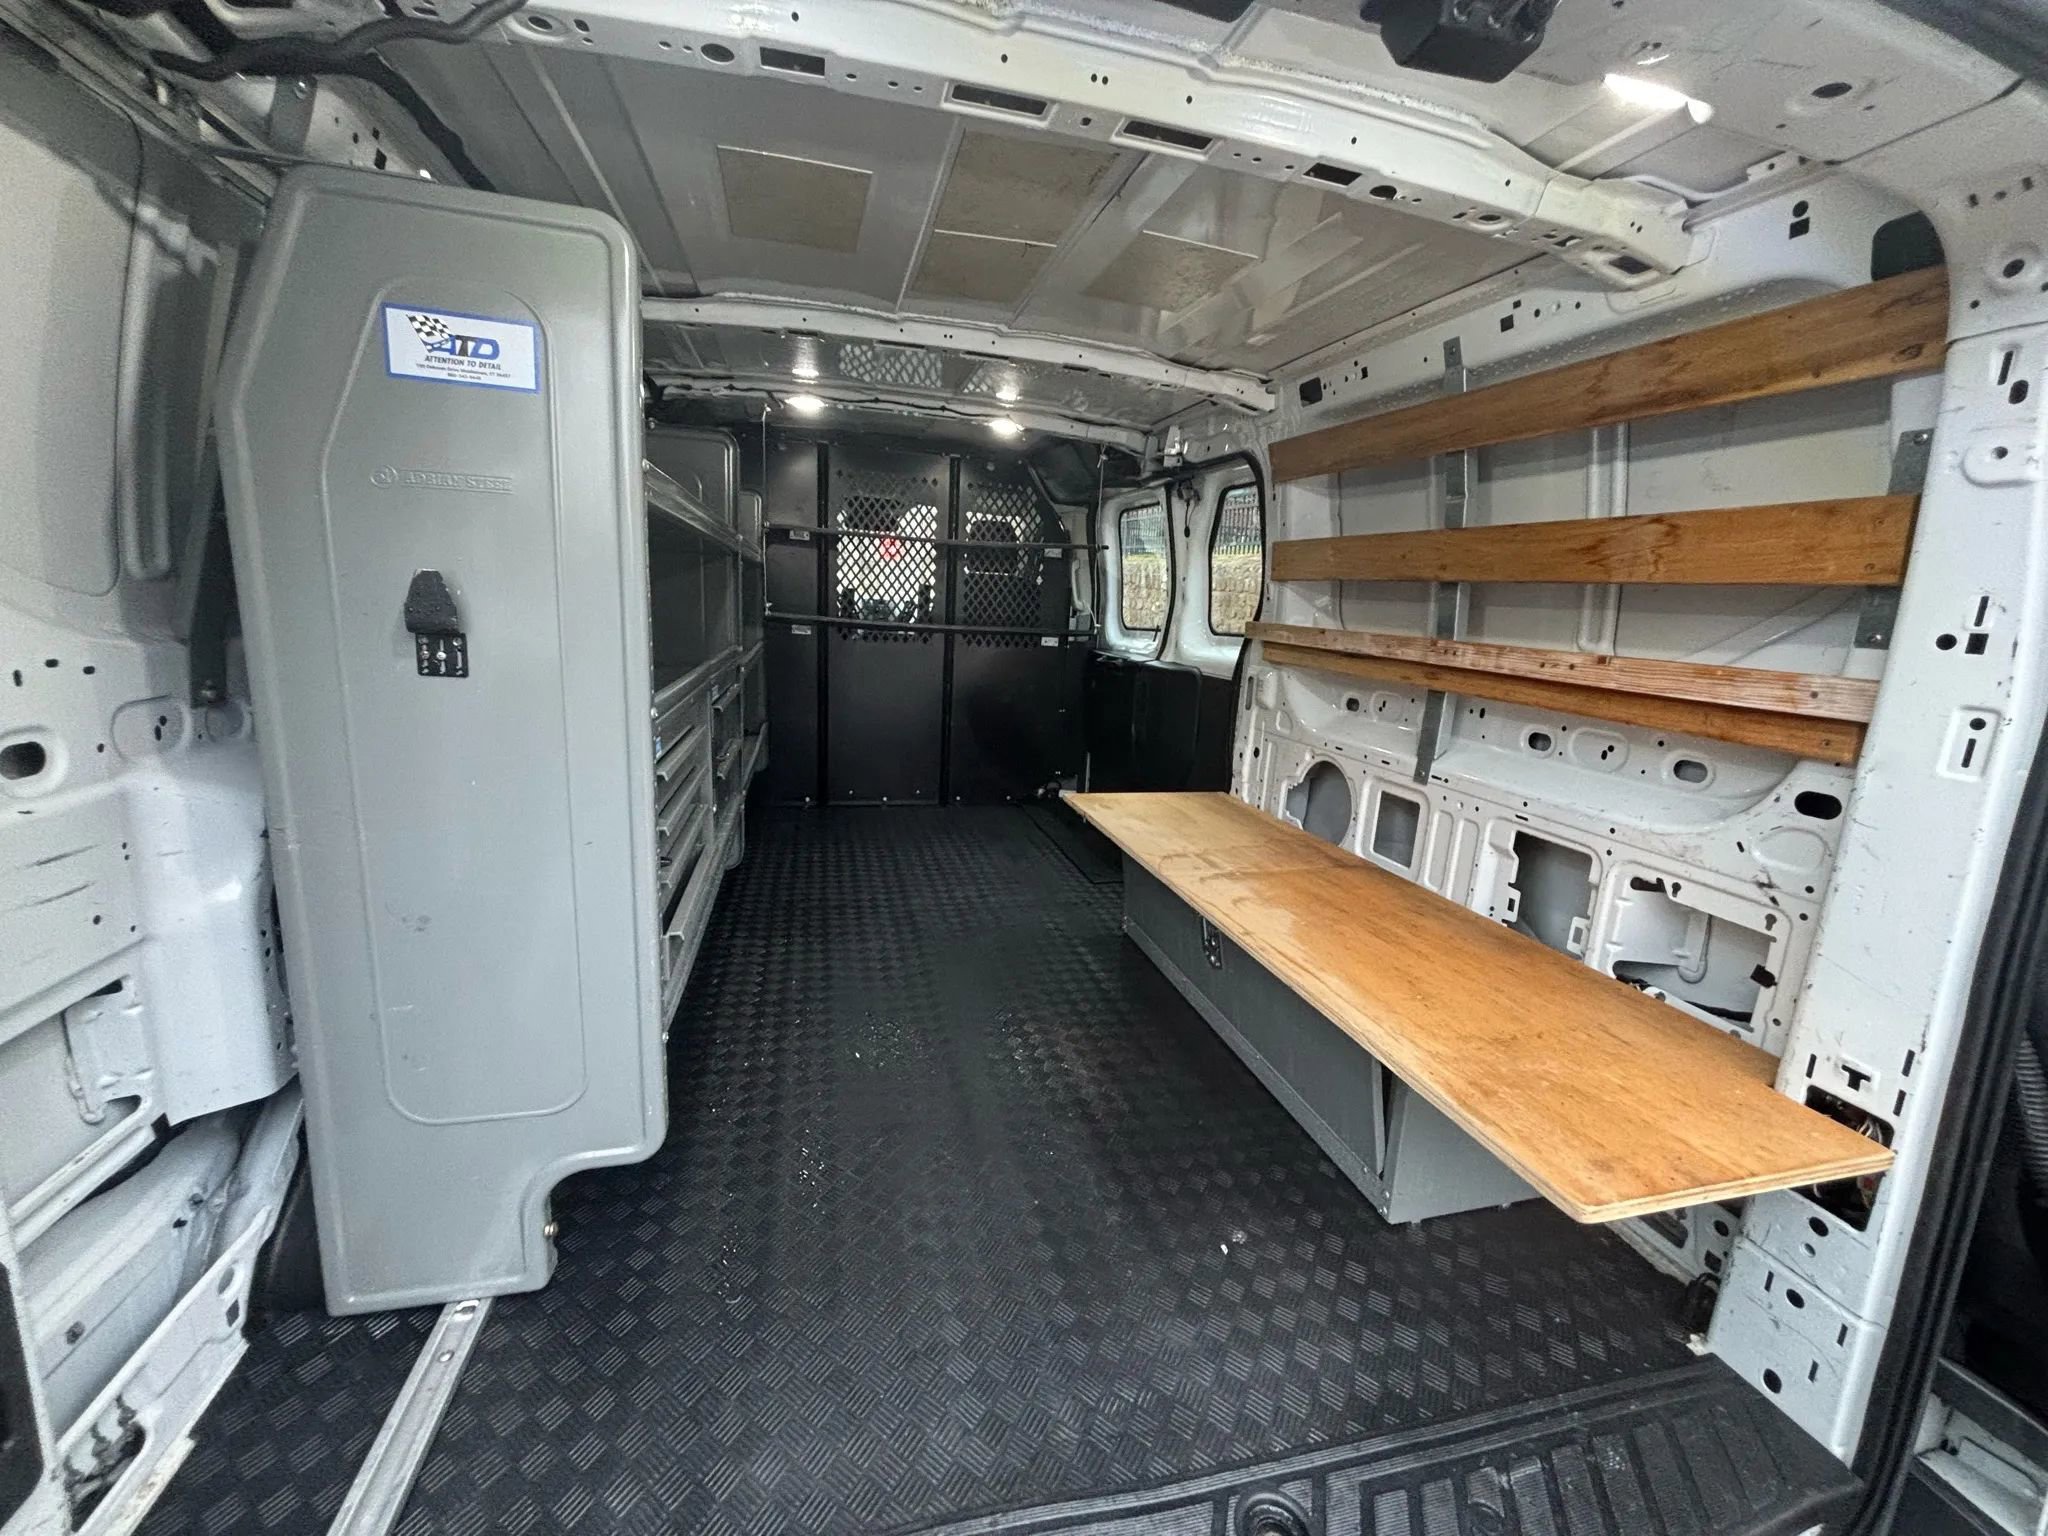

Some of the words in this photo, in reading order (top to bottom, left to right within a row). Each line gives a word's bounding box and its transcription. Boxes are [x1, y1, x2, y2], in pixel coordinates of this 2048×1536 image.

[424, 354, 465, 367] ATTENTION
[467, 360, 477, 368] TO
[479, 361, 502, 371] DETAIL
